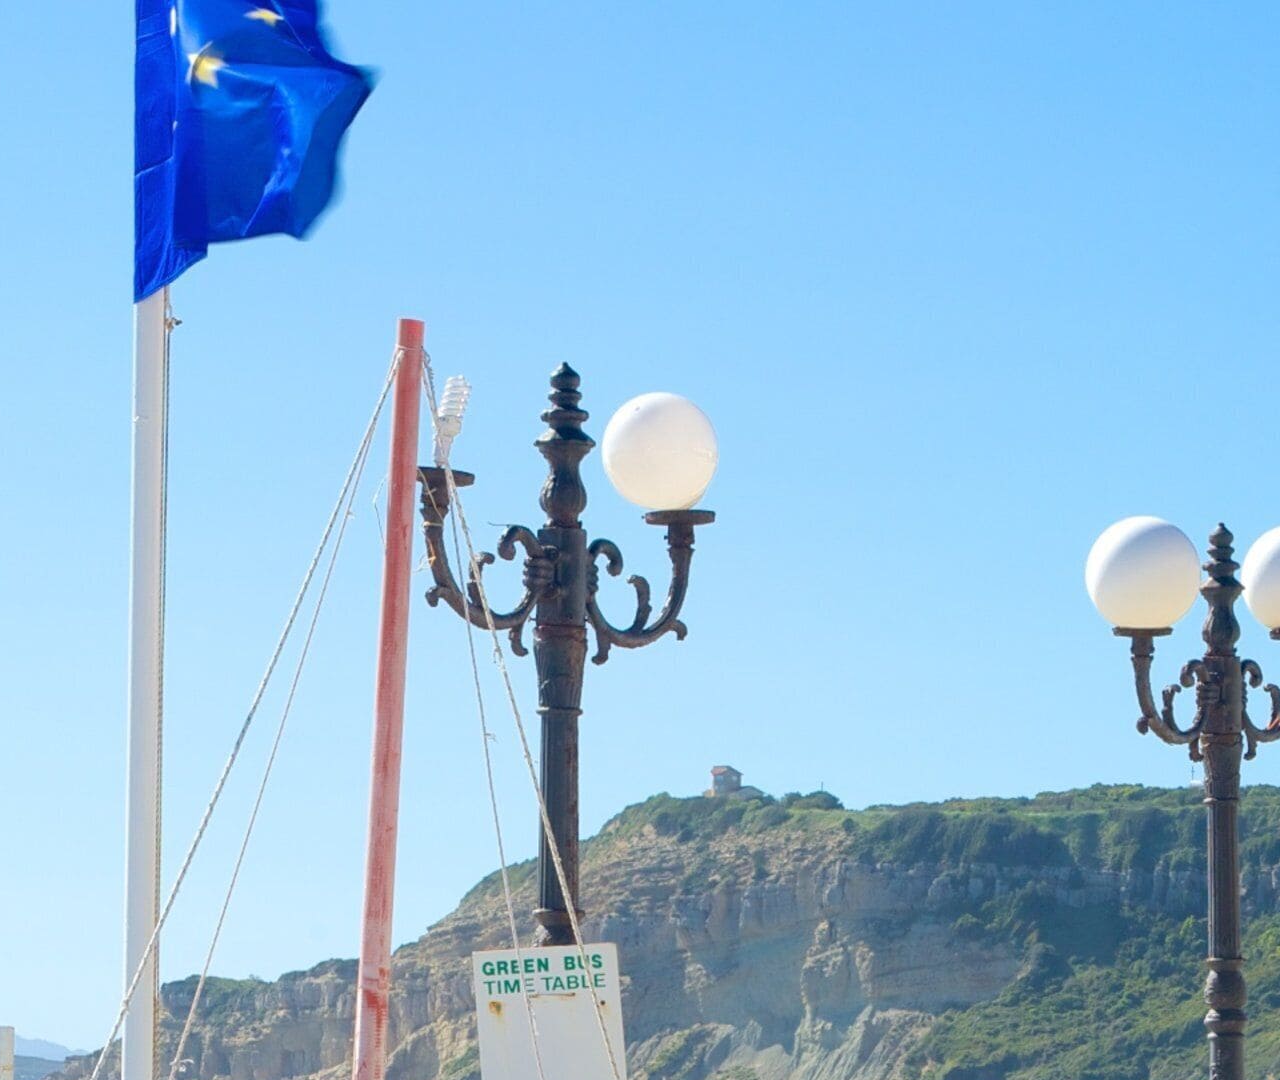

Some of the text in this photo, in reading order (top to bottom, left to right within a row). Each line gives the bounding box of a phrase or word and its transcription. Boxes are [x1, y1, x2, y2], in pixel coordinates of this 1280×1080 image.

[482, 957, 549, 976] GREEN
[483, 973, 606, 995] TIME TABLE
